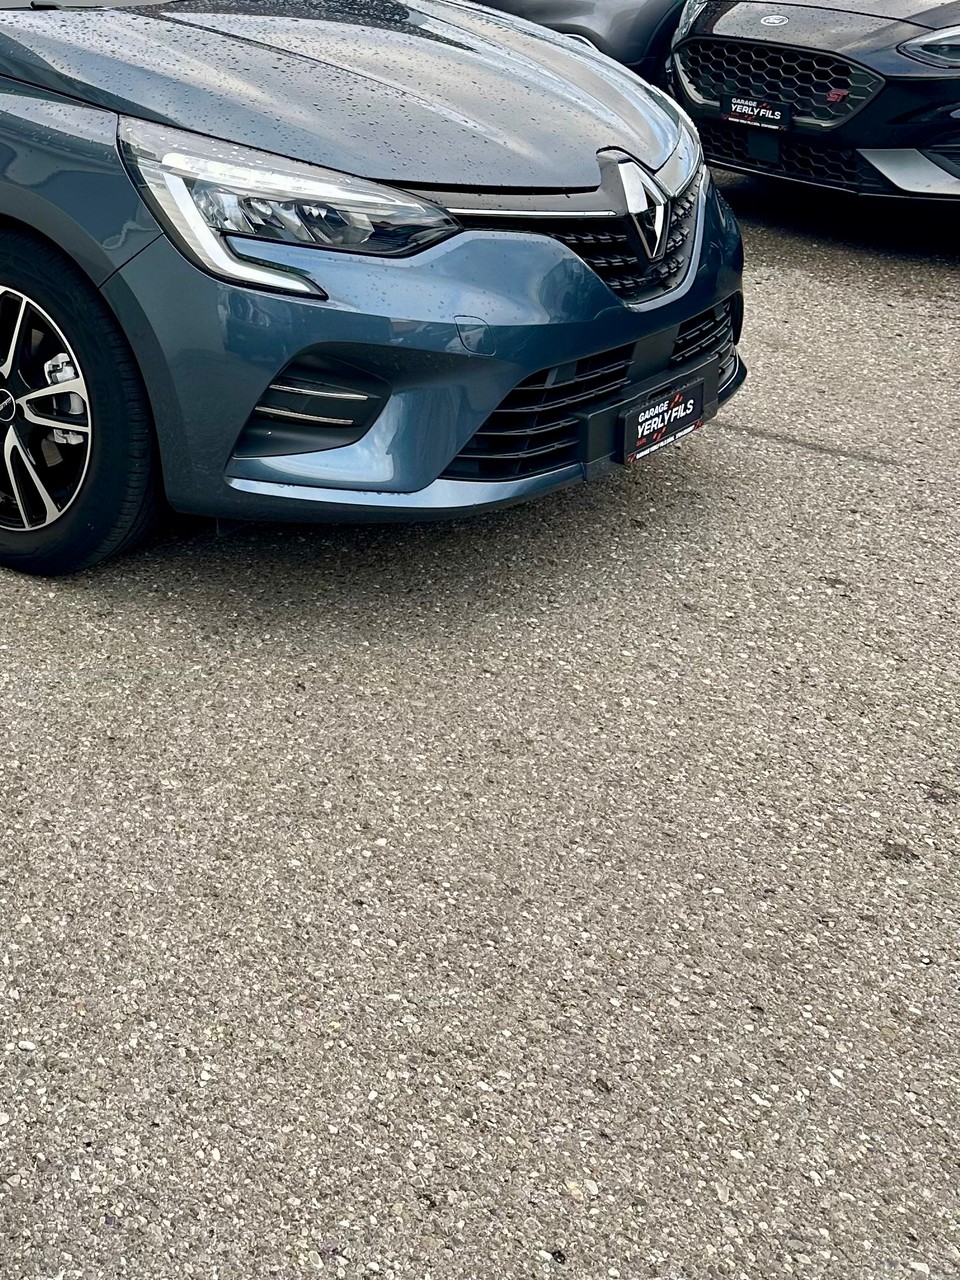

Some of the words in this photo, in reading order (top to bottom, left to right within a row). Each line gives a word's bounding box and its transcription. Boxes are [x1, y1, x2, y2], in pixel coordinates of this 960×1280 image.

[731, 98, 758, 107] GARAGE
[826, 89, 849, 102] ST
[730, 104, 760, 116] YERLY
[759, 108, 782, 120] FILS
[637, 410, 672, 439] YERLY
[670, 399, 695, 422] FILS
[638, 400, 670, 422] GARAGE
